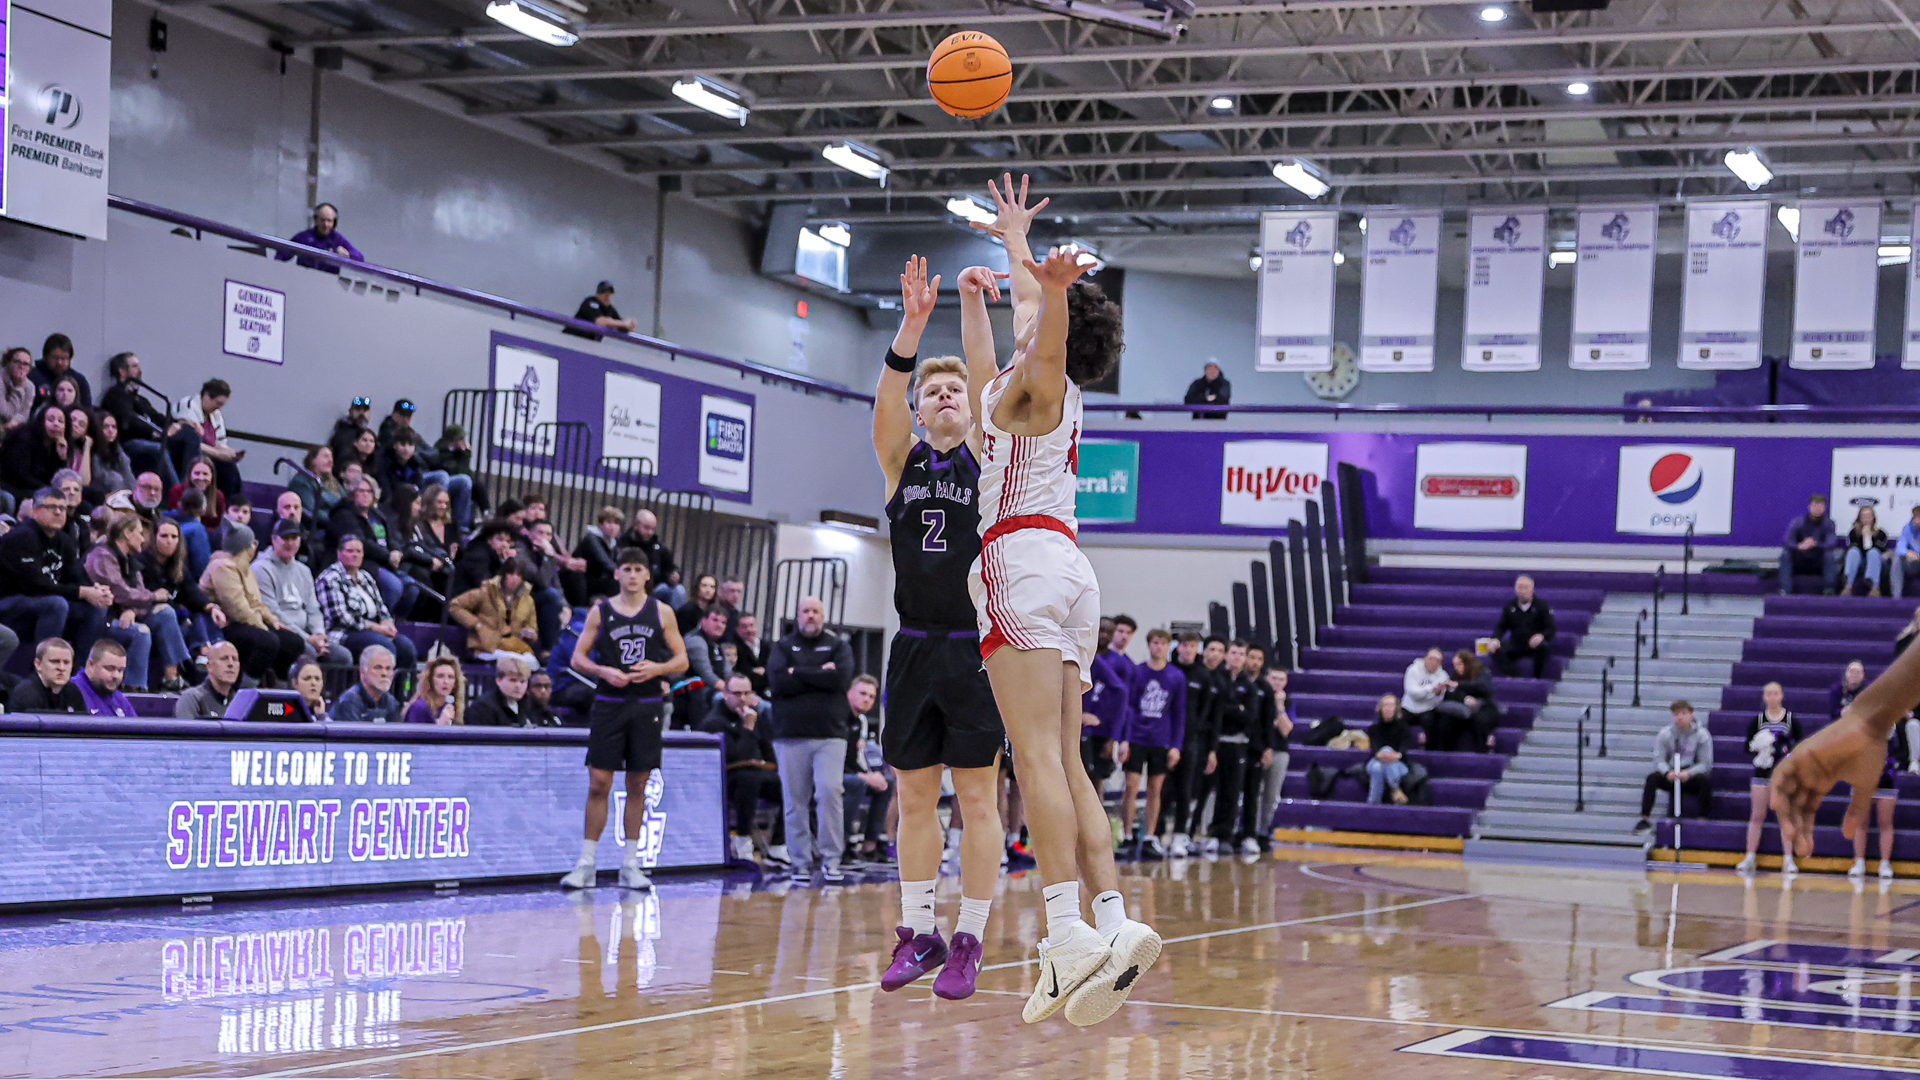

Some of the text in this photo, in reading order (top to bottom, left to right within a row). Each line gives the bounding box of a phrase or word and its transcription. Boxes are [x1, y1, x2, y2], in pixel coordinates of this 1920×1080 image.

[11, 124, 104, 160] First PREMIER Bank
[11, 143, 103, 179] PREMIER Bankcard
[717, 420, 744, 440] FIRST
[935, 480, 972, 505] FALLS
[1076, 477, 1108, 493] era
[1843, 475, 1920, 487] SIOUX FAL
[921, 509, 947, 551] 2
[618, 636, 646, 665] 23
[230, 750, 412, 787] WELCOME TO THE
[166, 797, 470, 870] STEWART CENTER
